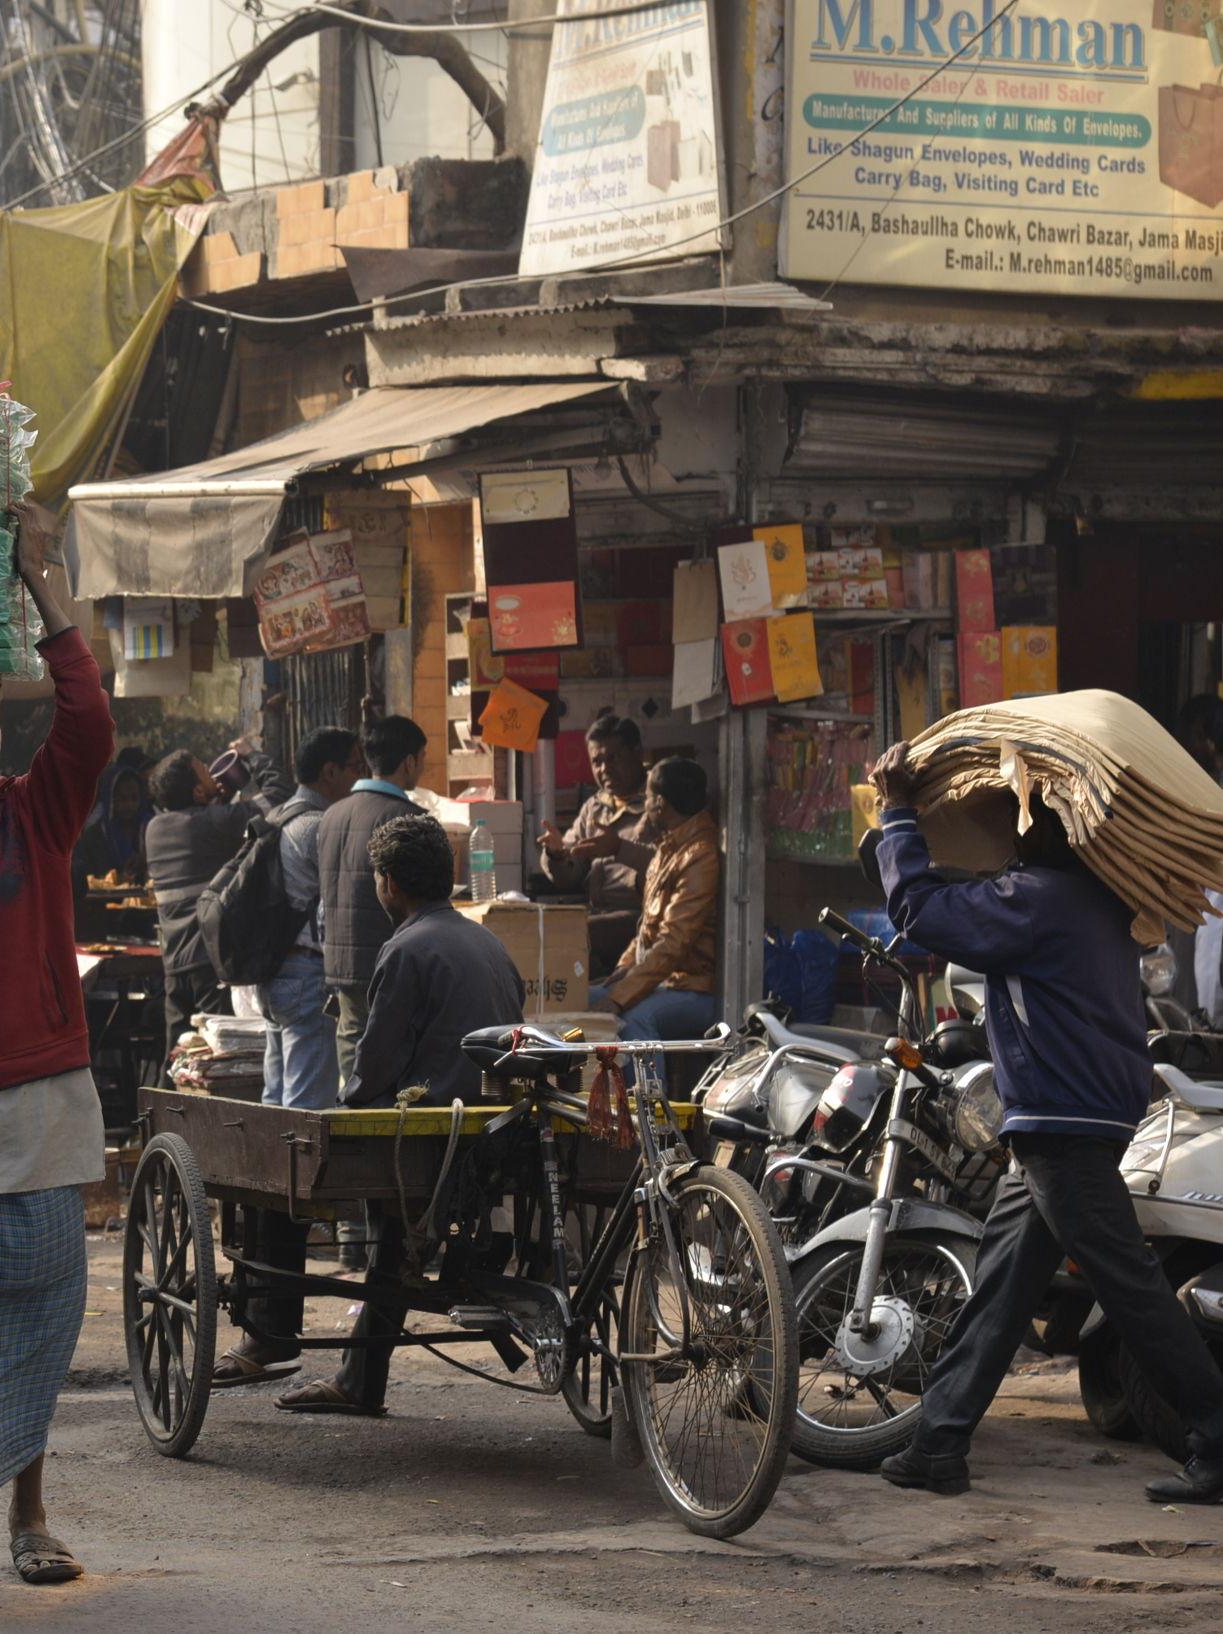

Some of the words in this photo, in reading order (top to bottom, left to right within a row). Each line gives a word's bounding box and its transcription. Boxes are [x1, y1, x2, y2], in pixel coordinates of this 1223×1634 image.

[811, 0, 1148, 72] M.Rehman
[853, 69, 911, 92] Whole
[919, 73, 966, 95] Saler
[975, 78, 988, 97] &
[996, 79, 1049, 101] Retail
[1057, 82, 1105, 105] Saler
[897, 105, 920, 125] And
[926, 107, 979, 131] Suppliers
[985, 113, 997, 130] of
[1003, 112, 1019, 131] All
[1026, 114, 1057, 134] Kinds
[1063, 116, 1077, 134] Of
[1083, 118, 1143, 141] Envelopes.
[807, 136, 844, 155] Like
[850, 139, 915, 163] Shagun
[921, 143, 1012, 169] Envelopes,
[1019, 149, 1091, 175] Wedding
[1097, 153, 1146, 174] Cards
[854, 166, 903, 191] Carry
[909, 170, 947, 193] Bag,
[954, 172, 1019, 198] Visiting
[1026, 176, 1065, 196] Card
[1072, 179, 1100, 198] Etc
[806, 208, 866, 238] 2431/A,
[871, 212, 959, 237] Bashaullha
[964, 216, 1021, 246] Chowk,
[1026, 219, 1081, 245] Chawri
[1086, 222, 1133, 251] Bazar,
[1138, 227, 1180, 250] Jama
[945, 248, 1004, 272] E-mail.:
[1009, 251, 1213, 284] M.rehman1485@gmail.com
[547, 1170, 565, 1239] NEELAM
